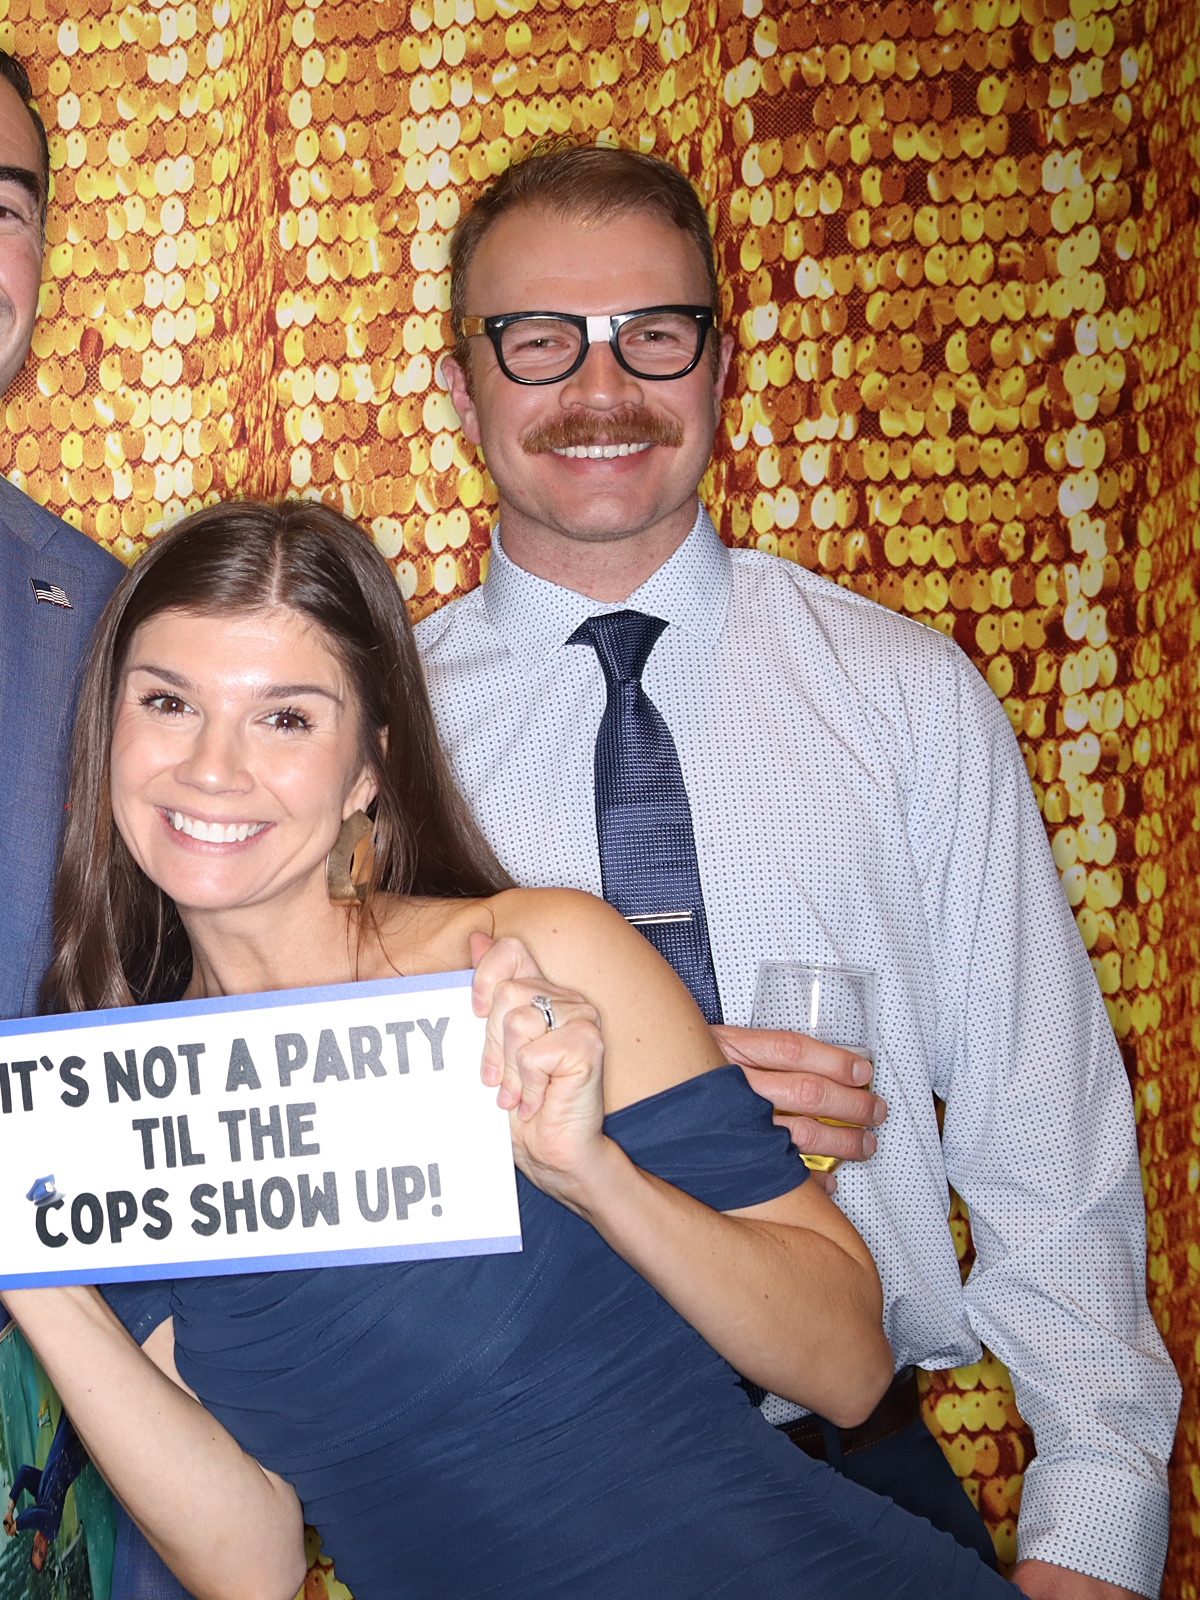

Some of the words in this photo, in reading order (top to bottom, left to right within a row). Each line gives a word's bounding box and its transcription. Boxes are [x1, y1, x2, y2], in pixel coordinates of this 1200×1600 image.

[103, 1042, 206, 1103] NOT
[224, 1037, 262, 1093] A
[274, 1016, 451, 1087] PARTY
[132, 1114, 206, 1170] TIL
[217, 1101, 321, 1163] THE
[34, 1187, 173, 1249] COPS
[189, 1171, 341, 1237] SHOW
[354, 1162, 443, 1223] UP!
